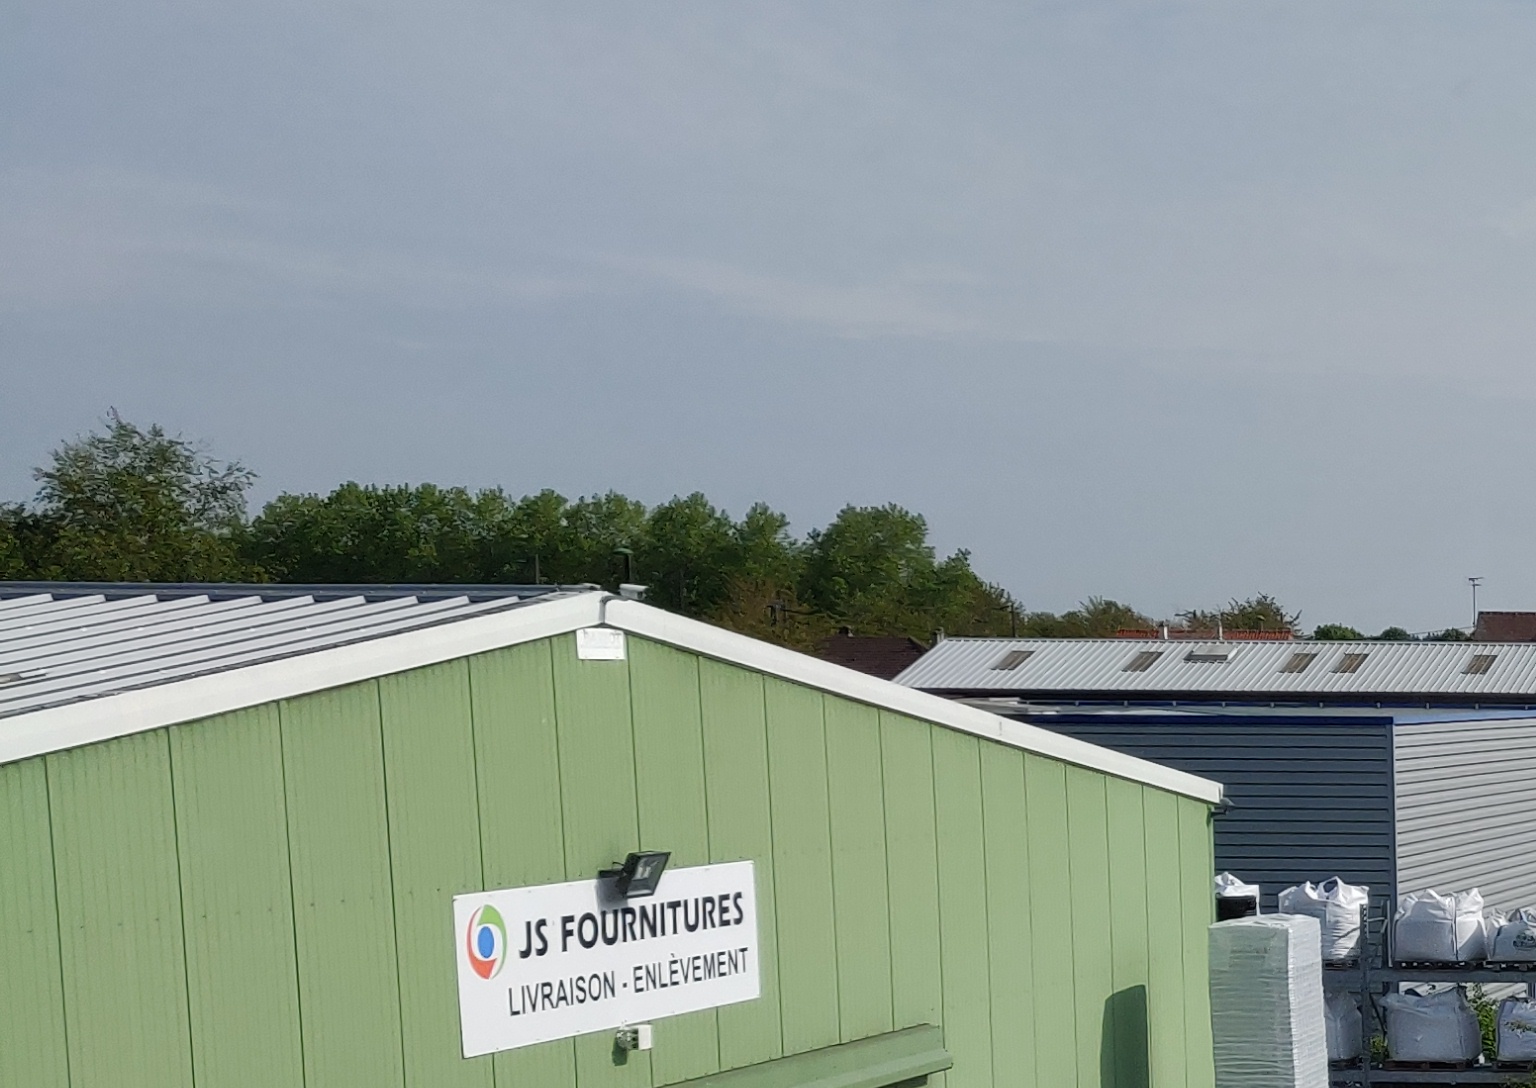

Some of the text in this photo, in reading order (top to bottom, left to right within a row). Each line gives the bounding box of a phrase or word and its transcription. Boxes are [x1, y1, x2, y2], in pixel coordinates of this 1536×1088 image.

[519, 891, 744, 959] JS FOURNITURES
[508, 970, 616, 1016] LIVRAISON
[633, 946, 748, 994] ENLÈVEMENT
